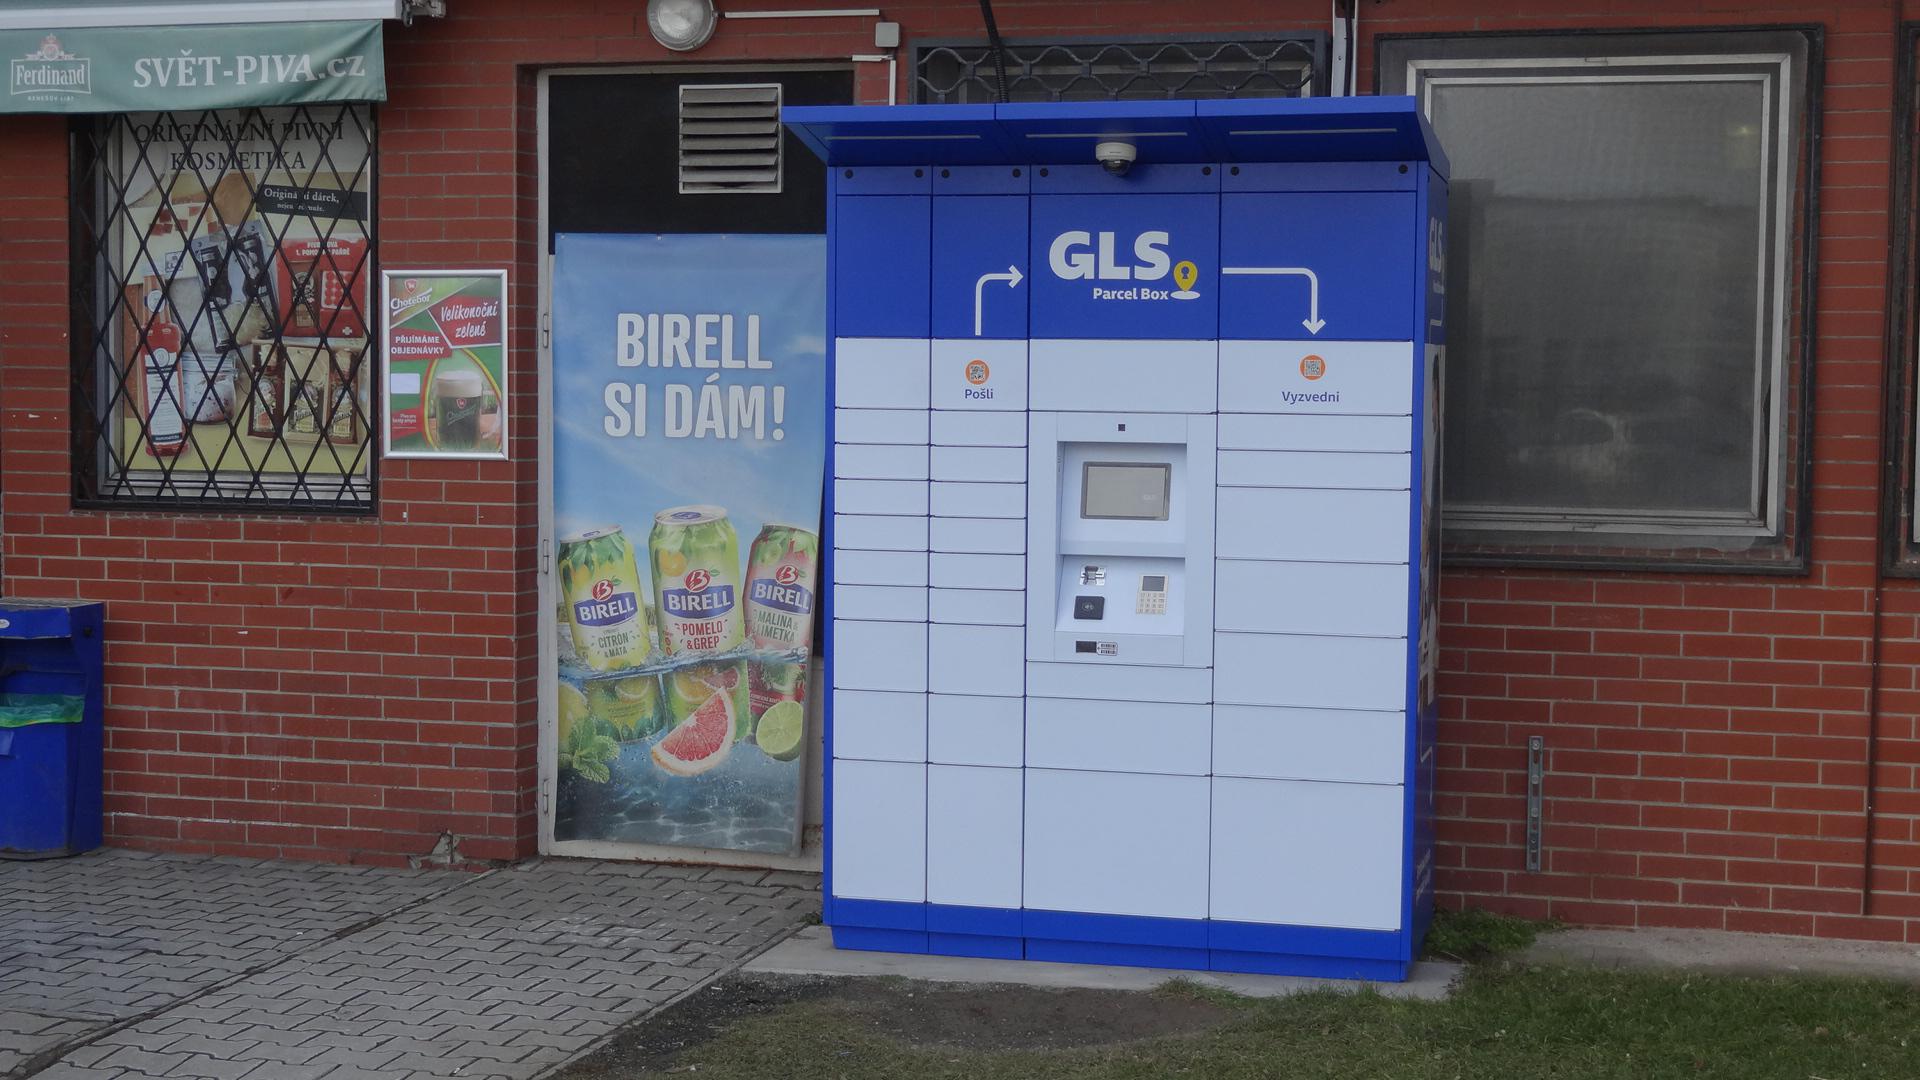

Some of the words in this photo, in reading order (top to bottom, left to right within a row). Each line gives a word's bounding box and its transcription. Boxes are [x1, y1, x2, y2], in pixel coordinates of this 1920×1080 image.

[16, 64, 85, 85] Ferdinand
[133, 49, 365, 88] SVĚT-PIVA.cz
[135, 119, 274, 143] ORIGINÁLNÍ
[281, 118, 344, 141] PIVNÍ
[171, 151, 306, 171] KOSMETIKA
[264, 188, 310, 200] Originání
[1049, 231, 1171, 280] GLS
[1093, 287, 1138, 300] Parcel
[1141, 288, 1169, 300] Box
[441, 301, 499, 321] Velikonoční
[395, 334, 440, 343] PŘIJÍMÁME
[455, 321, 486, 338] zelené
[391, 345, 444, 354] OBJEDNÁVKY
[616, 313, 773, 369] BIRELL
[964, 387, 993, 399] Pošli
[1281, 391, 1340, 405] Vyzvedni
[604, 382, 647, 437] SI
[664, 372, 785, 441] DÁM!
[668, 591, 731, 611] BIRELL
[755, 583, 809, 610] BIRELL
[580, 597, 635, 621] BIRELL
[682, 621, 723, 636] POMELO
[757, 610, 792, 630] MALINA
